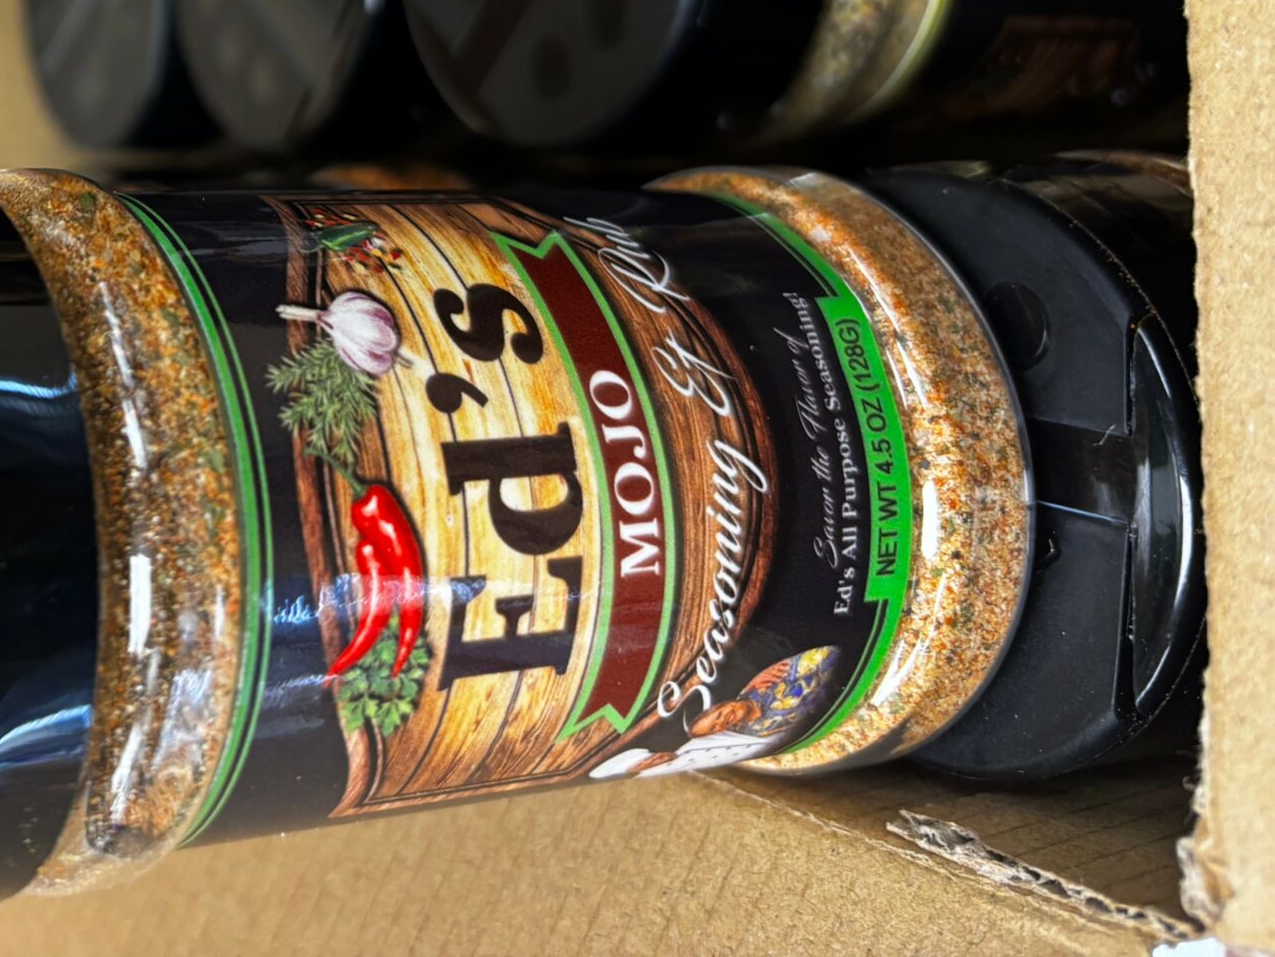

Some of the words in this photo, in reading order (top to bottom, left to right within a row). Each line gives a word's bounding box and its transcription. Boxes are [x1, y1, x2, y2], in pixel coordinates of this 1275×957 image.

[562, 215, 692, 315] Rub
[772, 325, 810, 355] of
[780, 291, 843, 412] Seasoning!
[834, 317, 882, 393] (128G)
[793, 357, 829, 440] Flavor
[860, 396, 888, 433] OZ
[424, 282, 584, 692] Ed's
[588, 369, 661, 579] MOJO
[809, 445, 833, 483] the
[832, 417, 859, 518] Purpose
[870, 438, 894, 475] 4.5
[812, 486, 839, 570] Savor
[876, 480, 898, 522] WT
[839, 525, 858, 560] All
[874, 527, 899, 577] NET
[656, 436, 769, 734] Seasoning
[832, 565, 856, 615] Ed's
